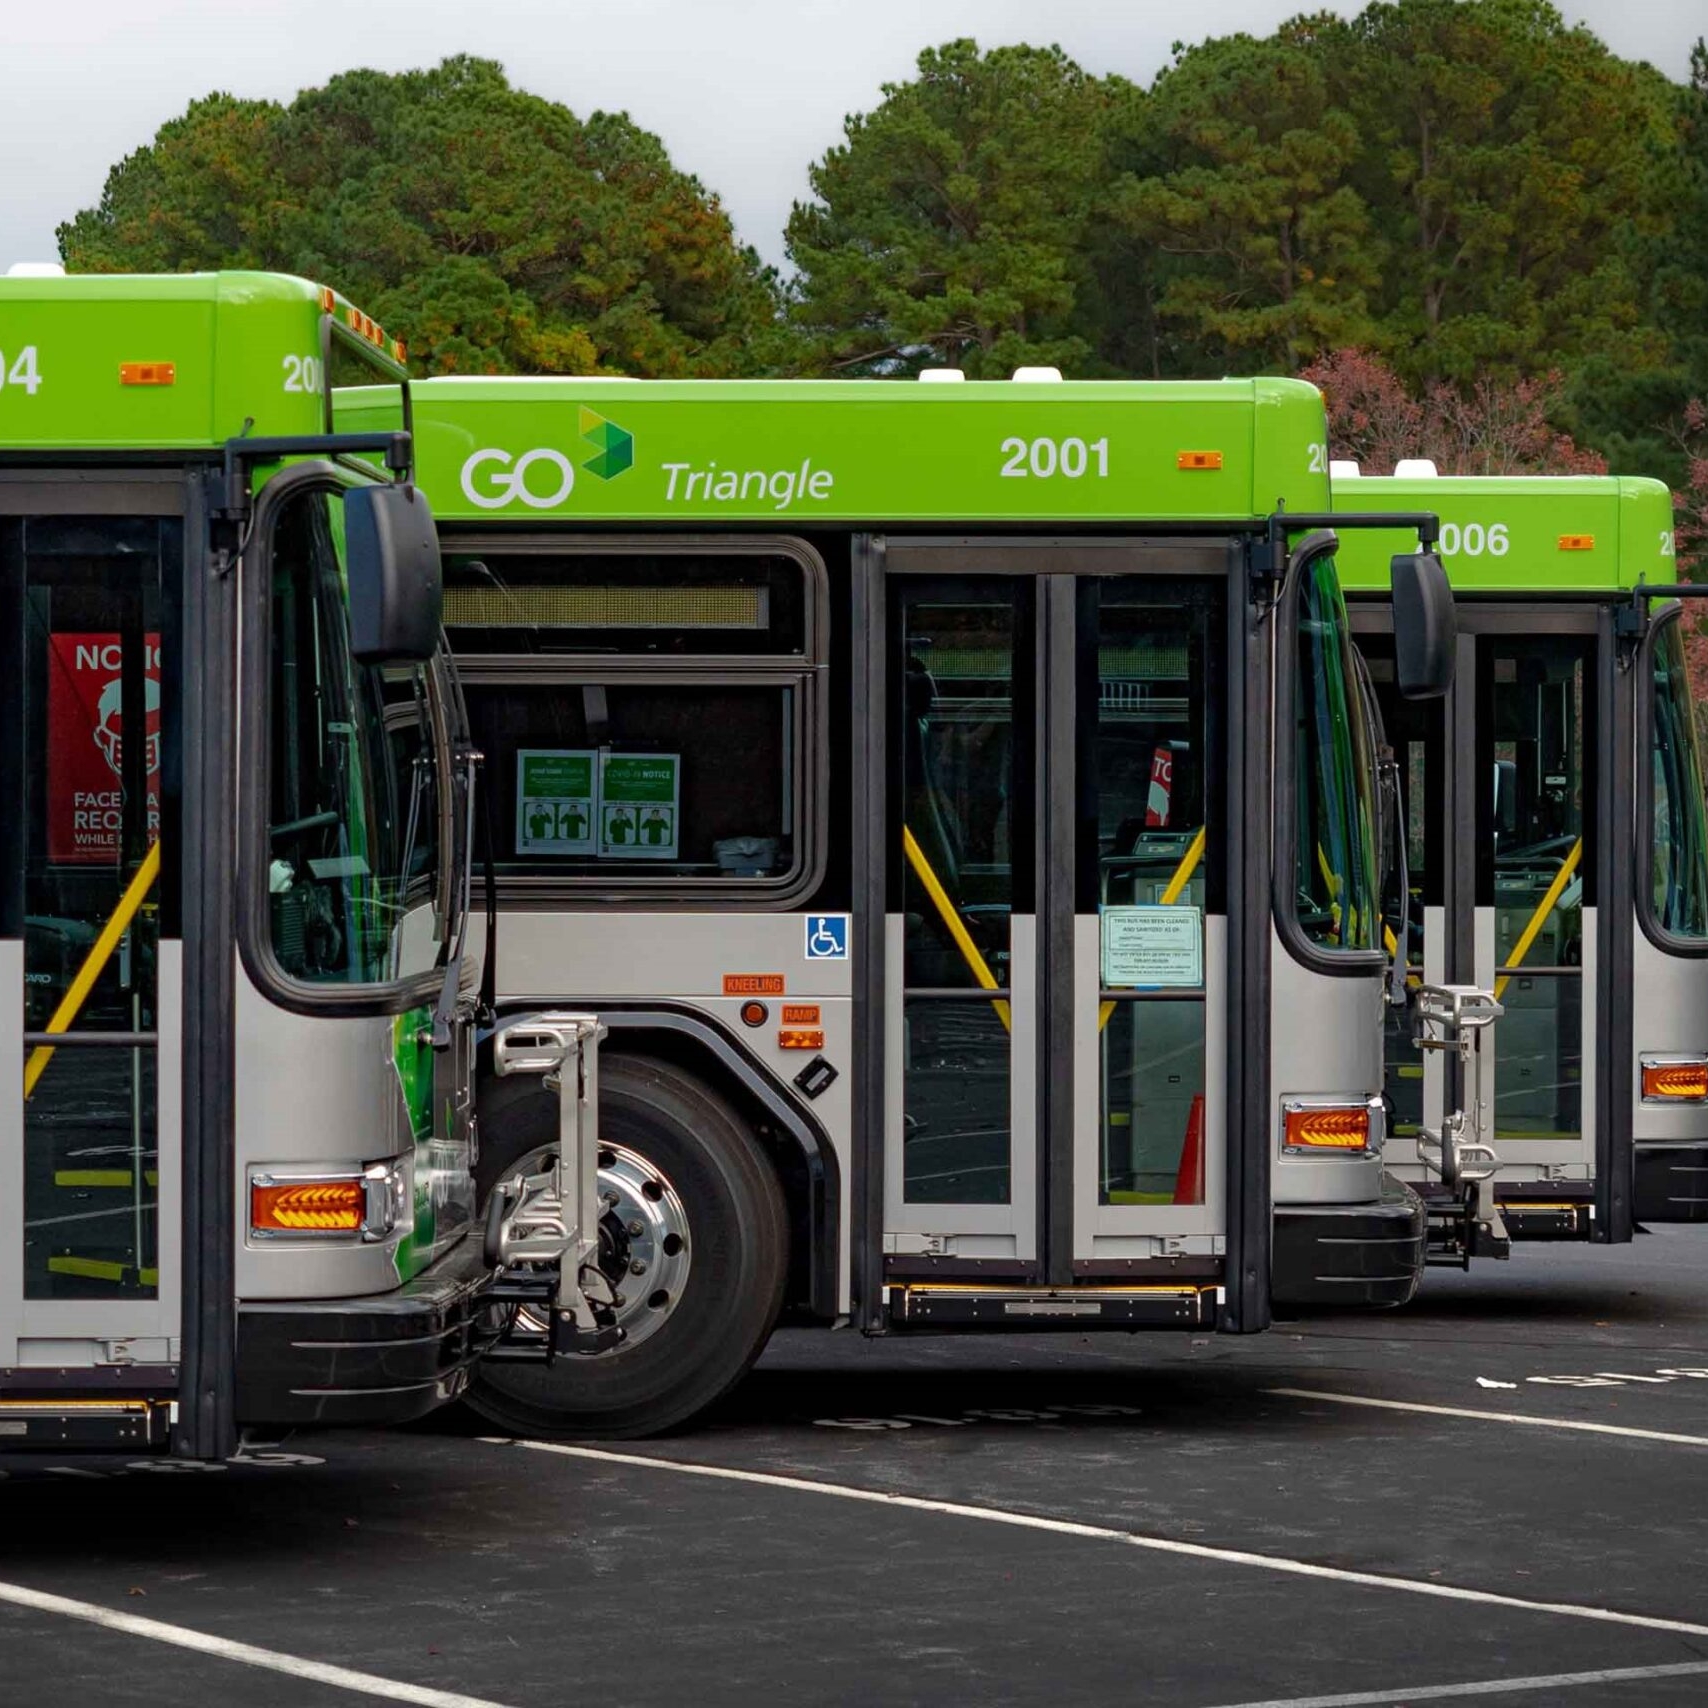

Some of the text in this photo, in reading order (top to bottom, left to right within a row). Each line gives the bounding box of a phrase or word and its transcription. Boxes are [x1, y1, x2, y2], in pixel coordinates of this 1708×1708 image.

[0, 346, 42, 395] 4
[1000, 437, 1108, 478] 2001
[460, 448, 574, 508] GO
[661, 458, 834, 510] Triangle
[1415, 523, 1510, 556] 006
[74, 792, 121, 807] FACE
[75, 833, 115, 845] WHILE
[727, 977, 781, 992] KNEELING
[785, 1009, 818, 1023] RAMP
